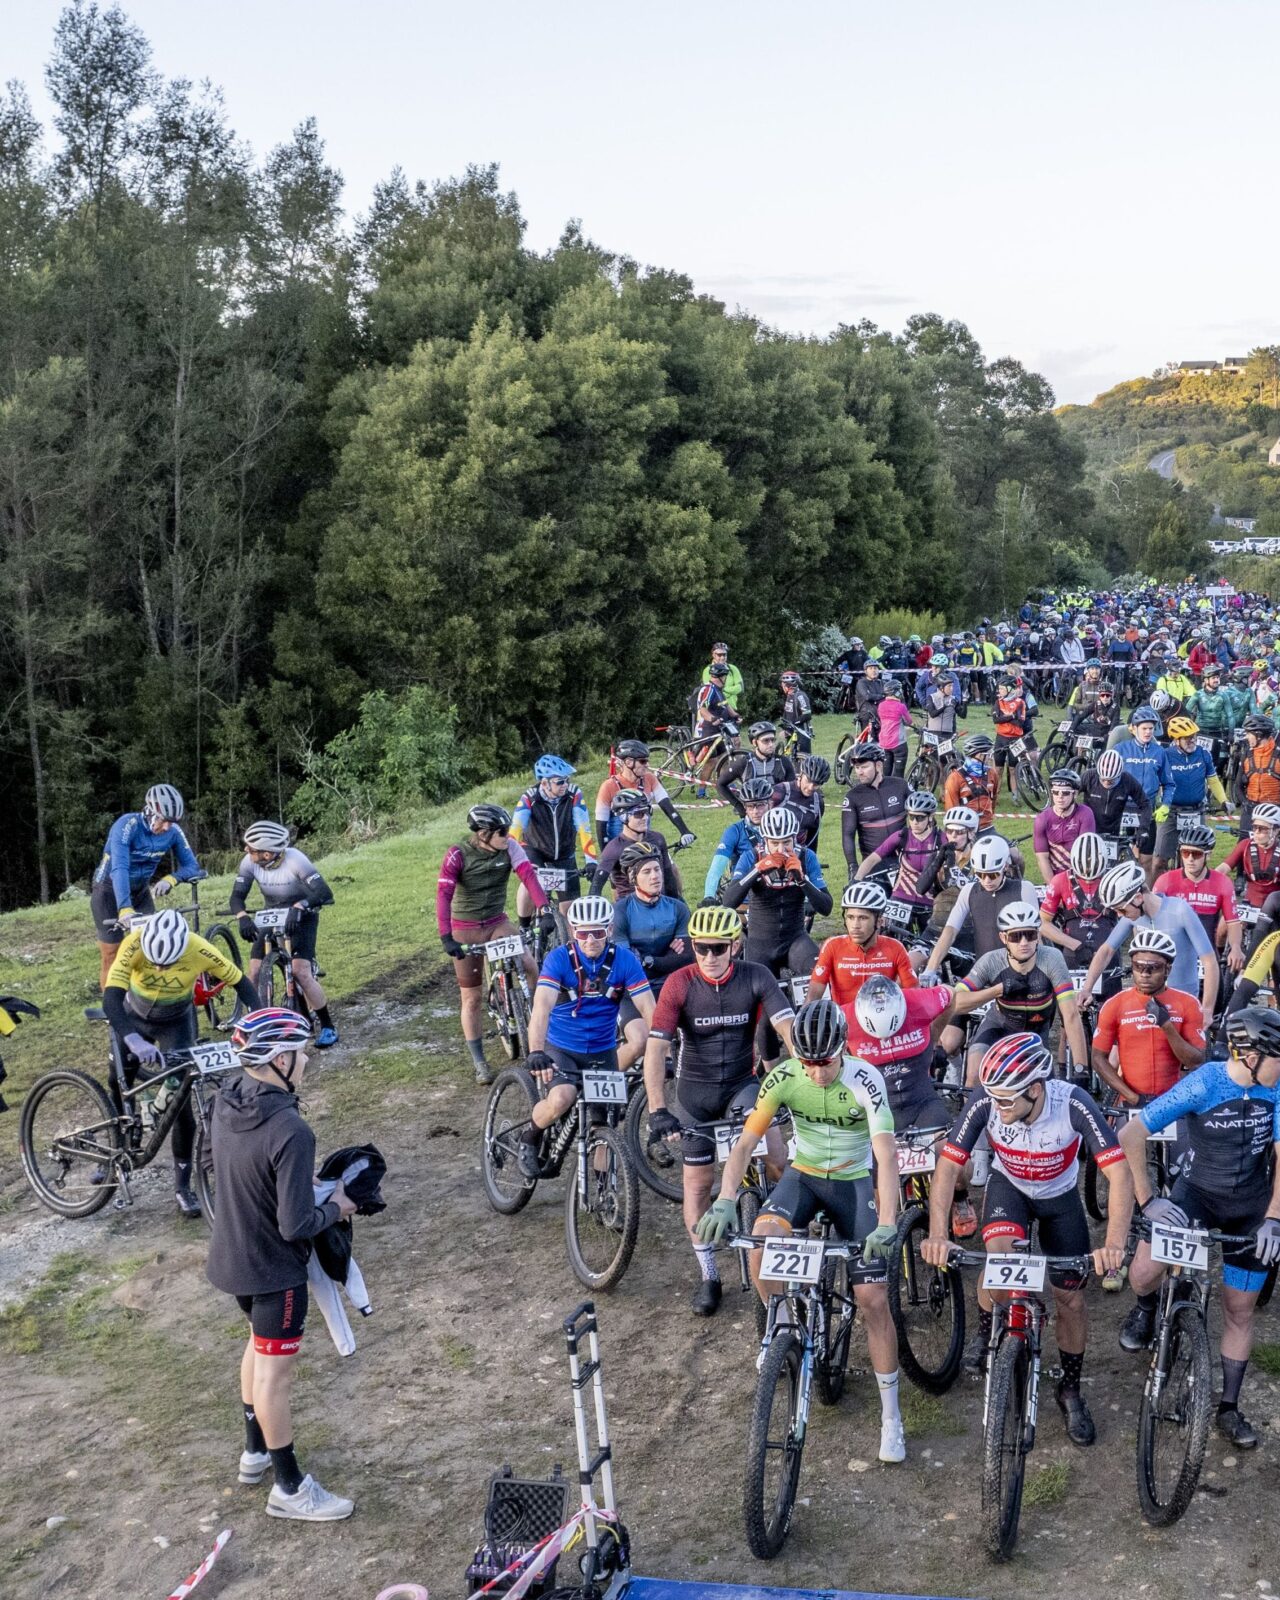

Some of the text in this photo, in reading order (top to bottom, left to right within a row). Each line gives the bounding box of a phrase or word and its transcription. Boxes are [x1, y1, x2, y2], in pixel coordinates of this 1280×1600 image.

[1198, 892, 1218, 904] RACE
[262, 915, 279, 924] 53
[493, 943, 516, 957] 179
[694, 1013, 750, 1027] COIMBRA
[893, 1028, 925, 1046] RACE
[201, 1051, 233, 1069] 229
[593, 1082, 617, 1099] 161
[1204, 1112, 1273, 1129] ANATOMIC
[1161, 1238, 1199, 1262] 157
[770, 1253, 810, 1276] 221
[999, 1266, 1030, 1285] 94
